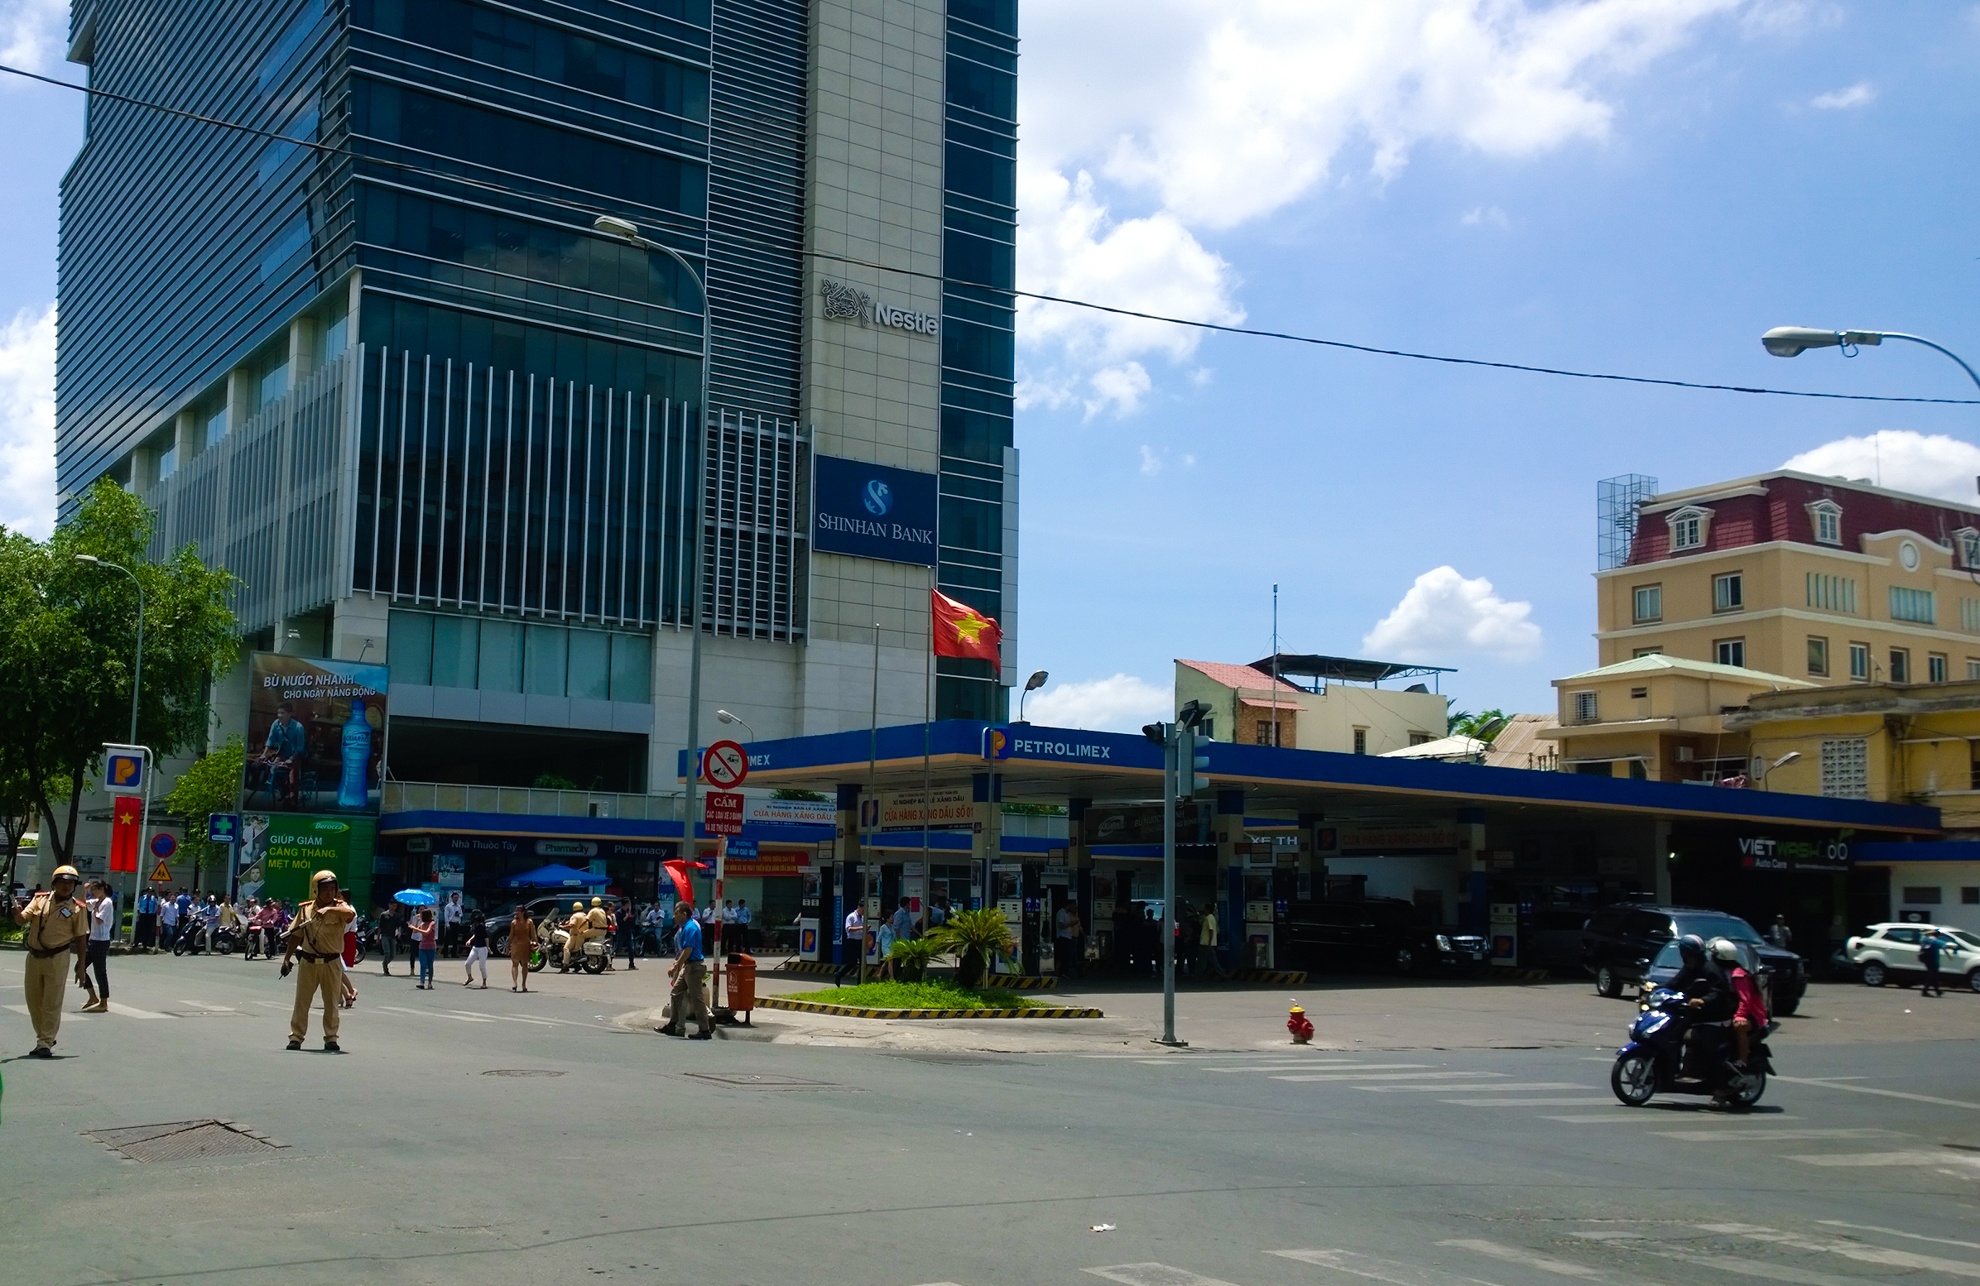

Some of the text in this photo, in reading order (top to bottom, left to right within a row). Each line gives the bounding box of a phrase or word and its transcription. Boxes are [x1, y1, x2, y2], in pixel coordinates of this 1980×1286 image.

[818, 512, 933, 545] SHINHAN BANK
[263, 672, 354, 687] BÙ NƯỚC NHANH
[284, 686, 376, 699] CHO NGÀY NĂNG ĐỘNG
[1014, 739, 1111, 759] PETROLIMEX
[747, 754, 770, 767] IMEX
[713, 794, 738, 808] CẤM
[899, 808, 917, 821] HÀNG
[939, 805, 954, 819] DẦU
[956, 804, 966, 818] SỐ
[315, 822, 343, 830] Berocca
[270, 834, 295, 845] GIÚP
[451, 840, 470, 849] Nhà
[502, 840, 517, 852] Tây
[1276, 836, 1298, 846] TH
[545, 843, 589, 855] Pharmacity
[614, 845, 668, 858] Pharmacy
